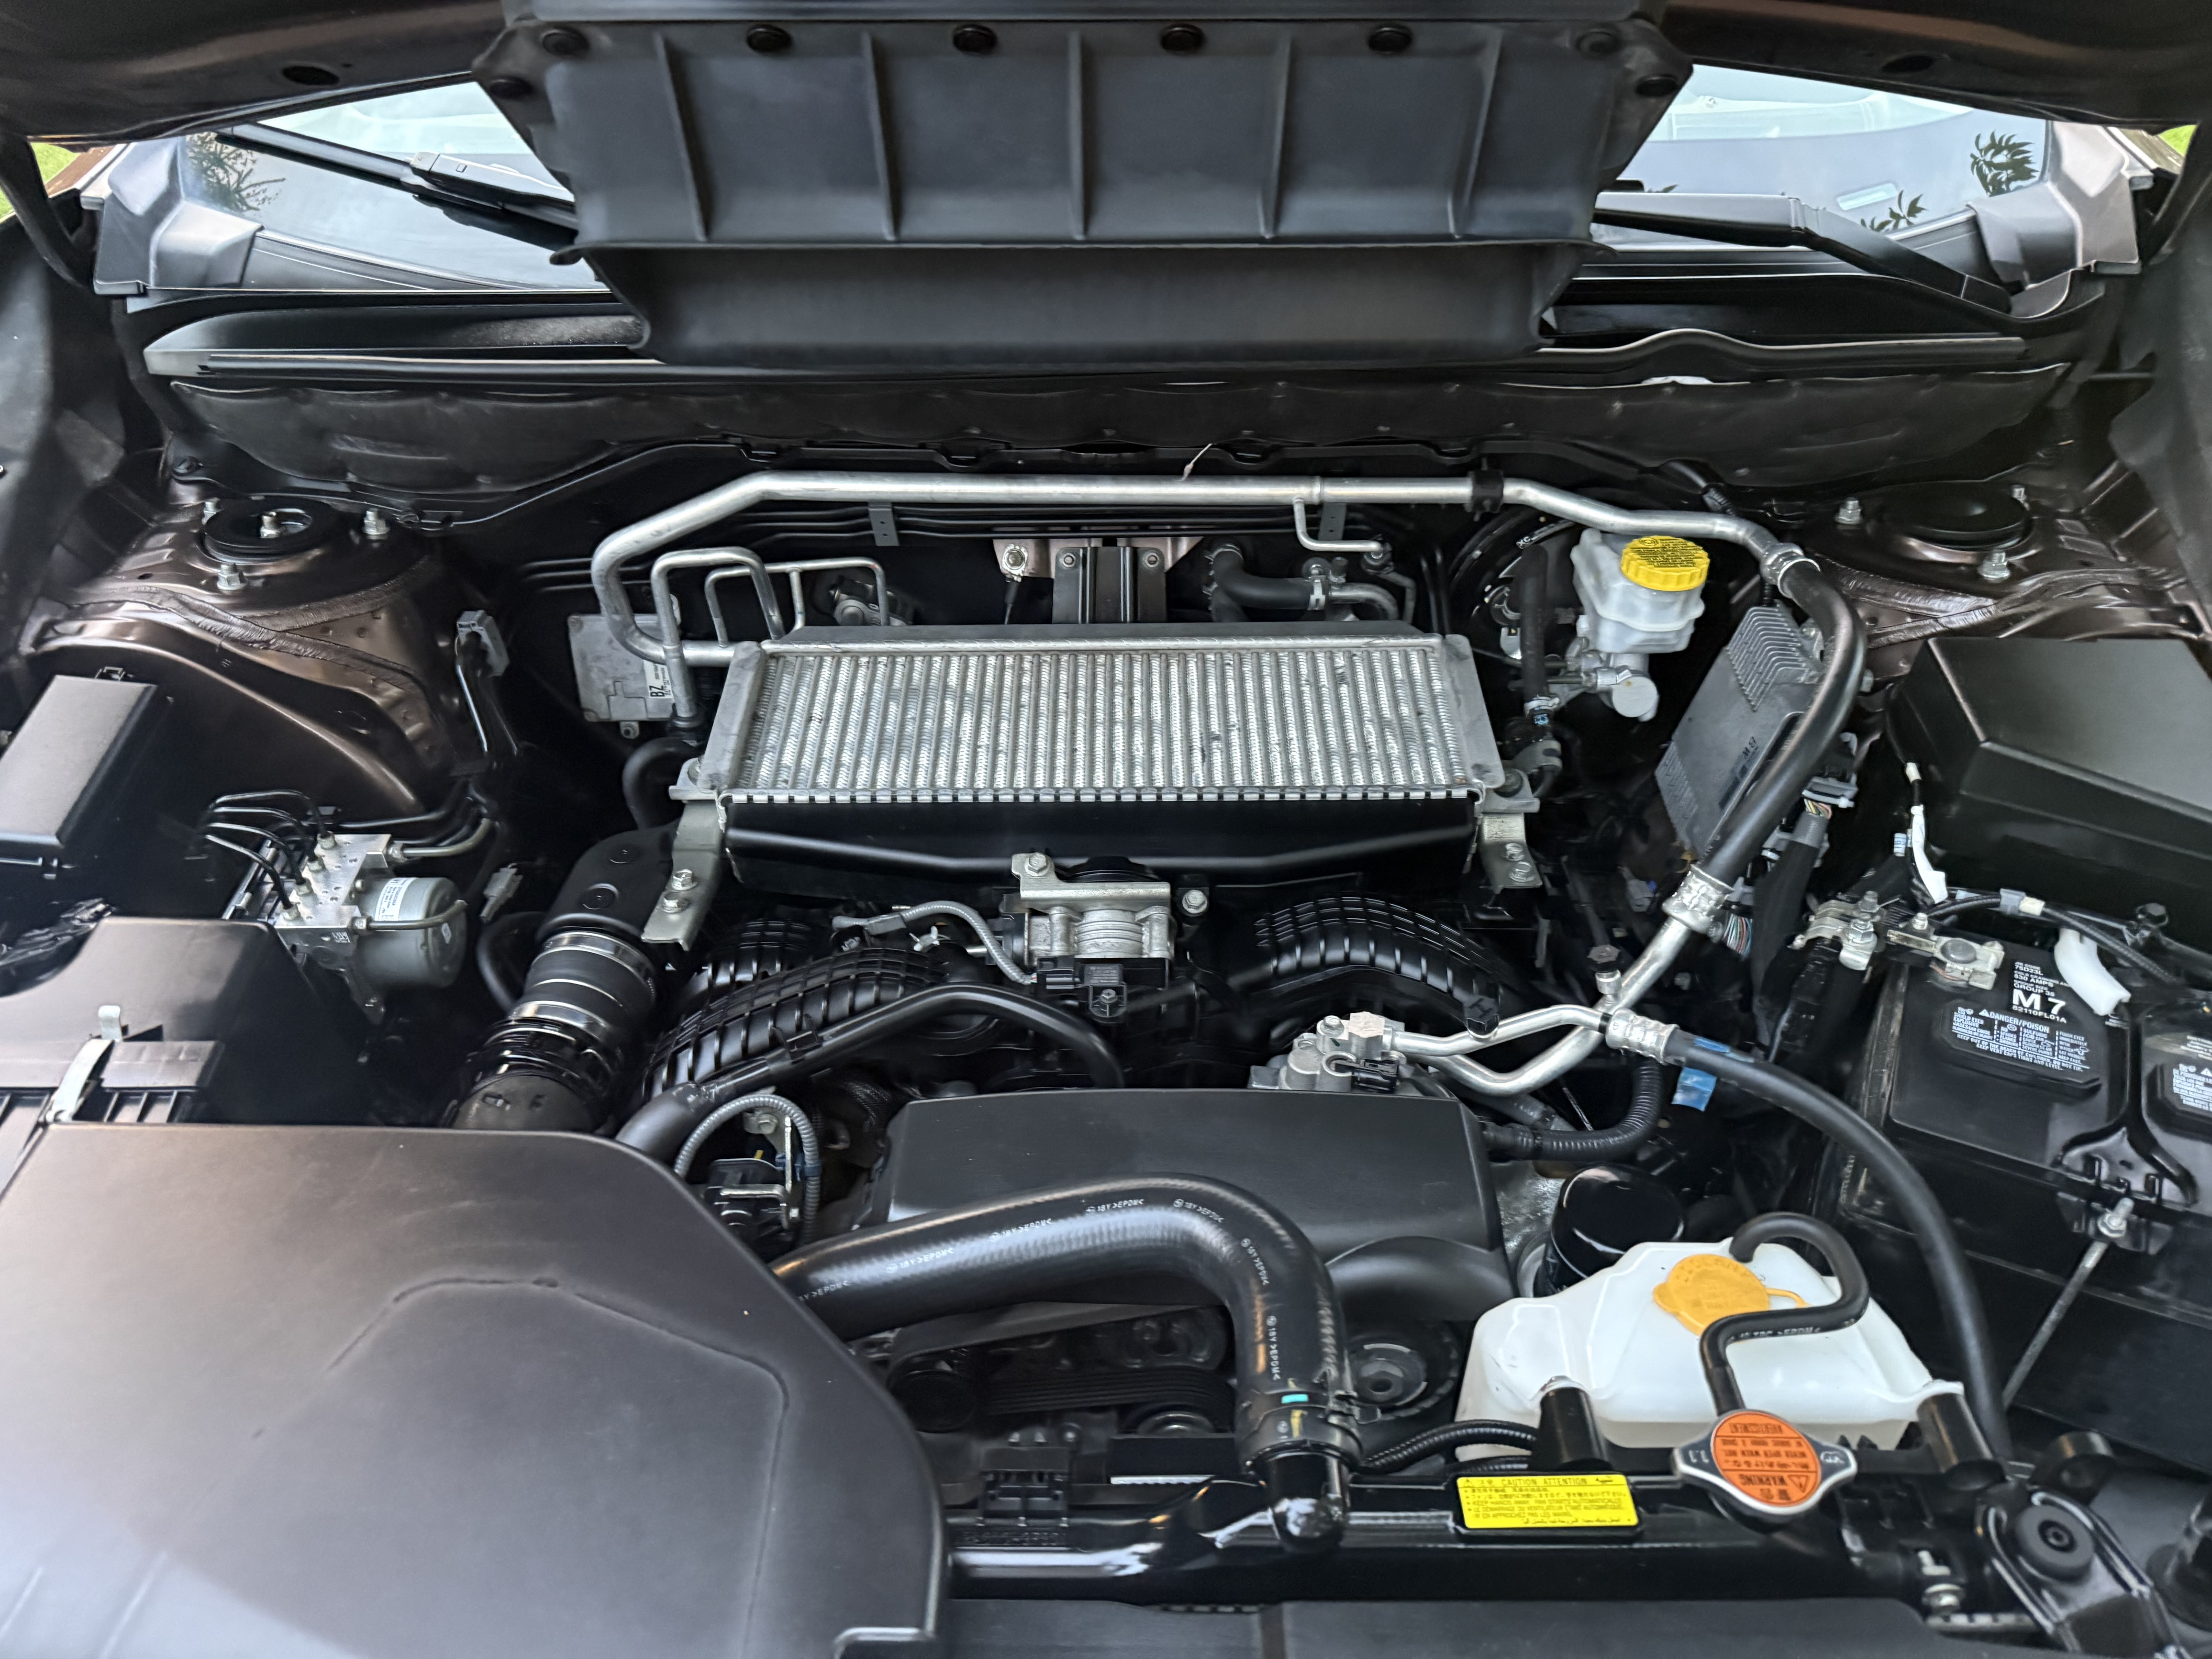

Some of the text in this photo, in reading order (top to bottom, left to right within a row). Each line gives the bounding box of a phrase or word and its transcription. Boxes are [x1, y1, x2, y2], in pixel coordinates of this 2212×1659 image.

[649, 686, 665, 697] BZ
[2014, 965, 2044, 975] 75D23L
[2030, 978, 2054, 987] AMPS
[2014, 983, 2044, 993] GROUP
[1990, 1012, 2050, 1034] DANGER/POISON
[1688, 1449, 1709, 1463] 1.1
[1544, 1477, 1587, 1486] ATTENTION
[1740, 1474, 1788, 1486] WARNING
